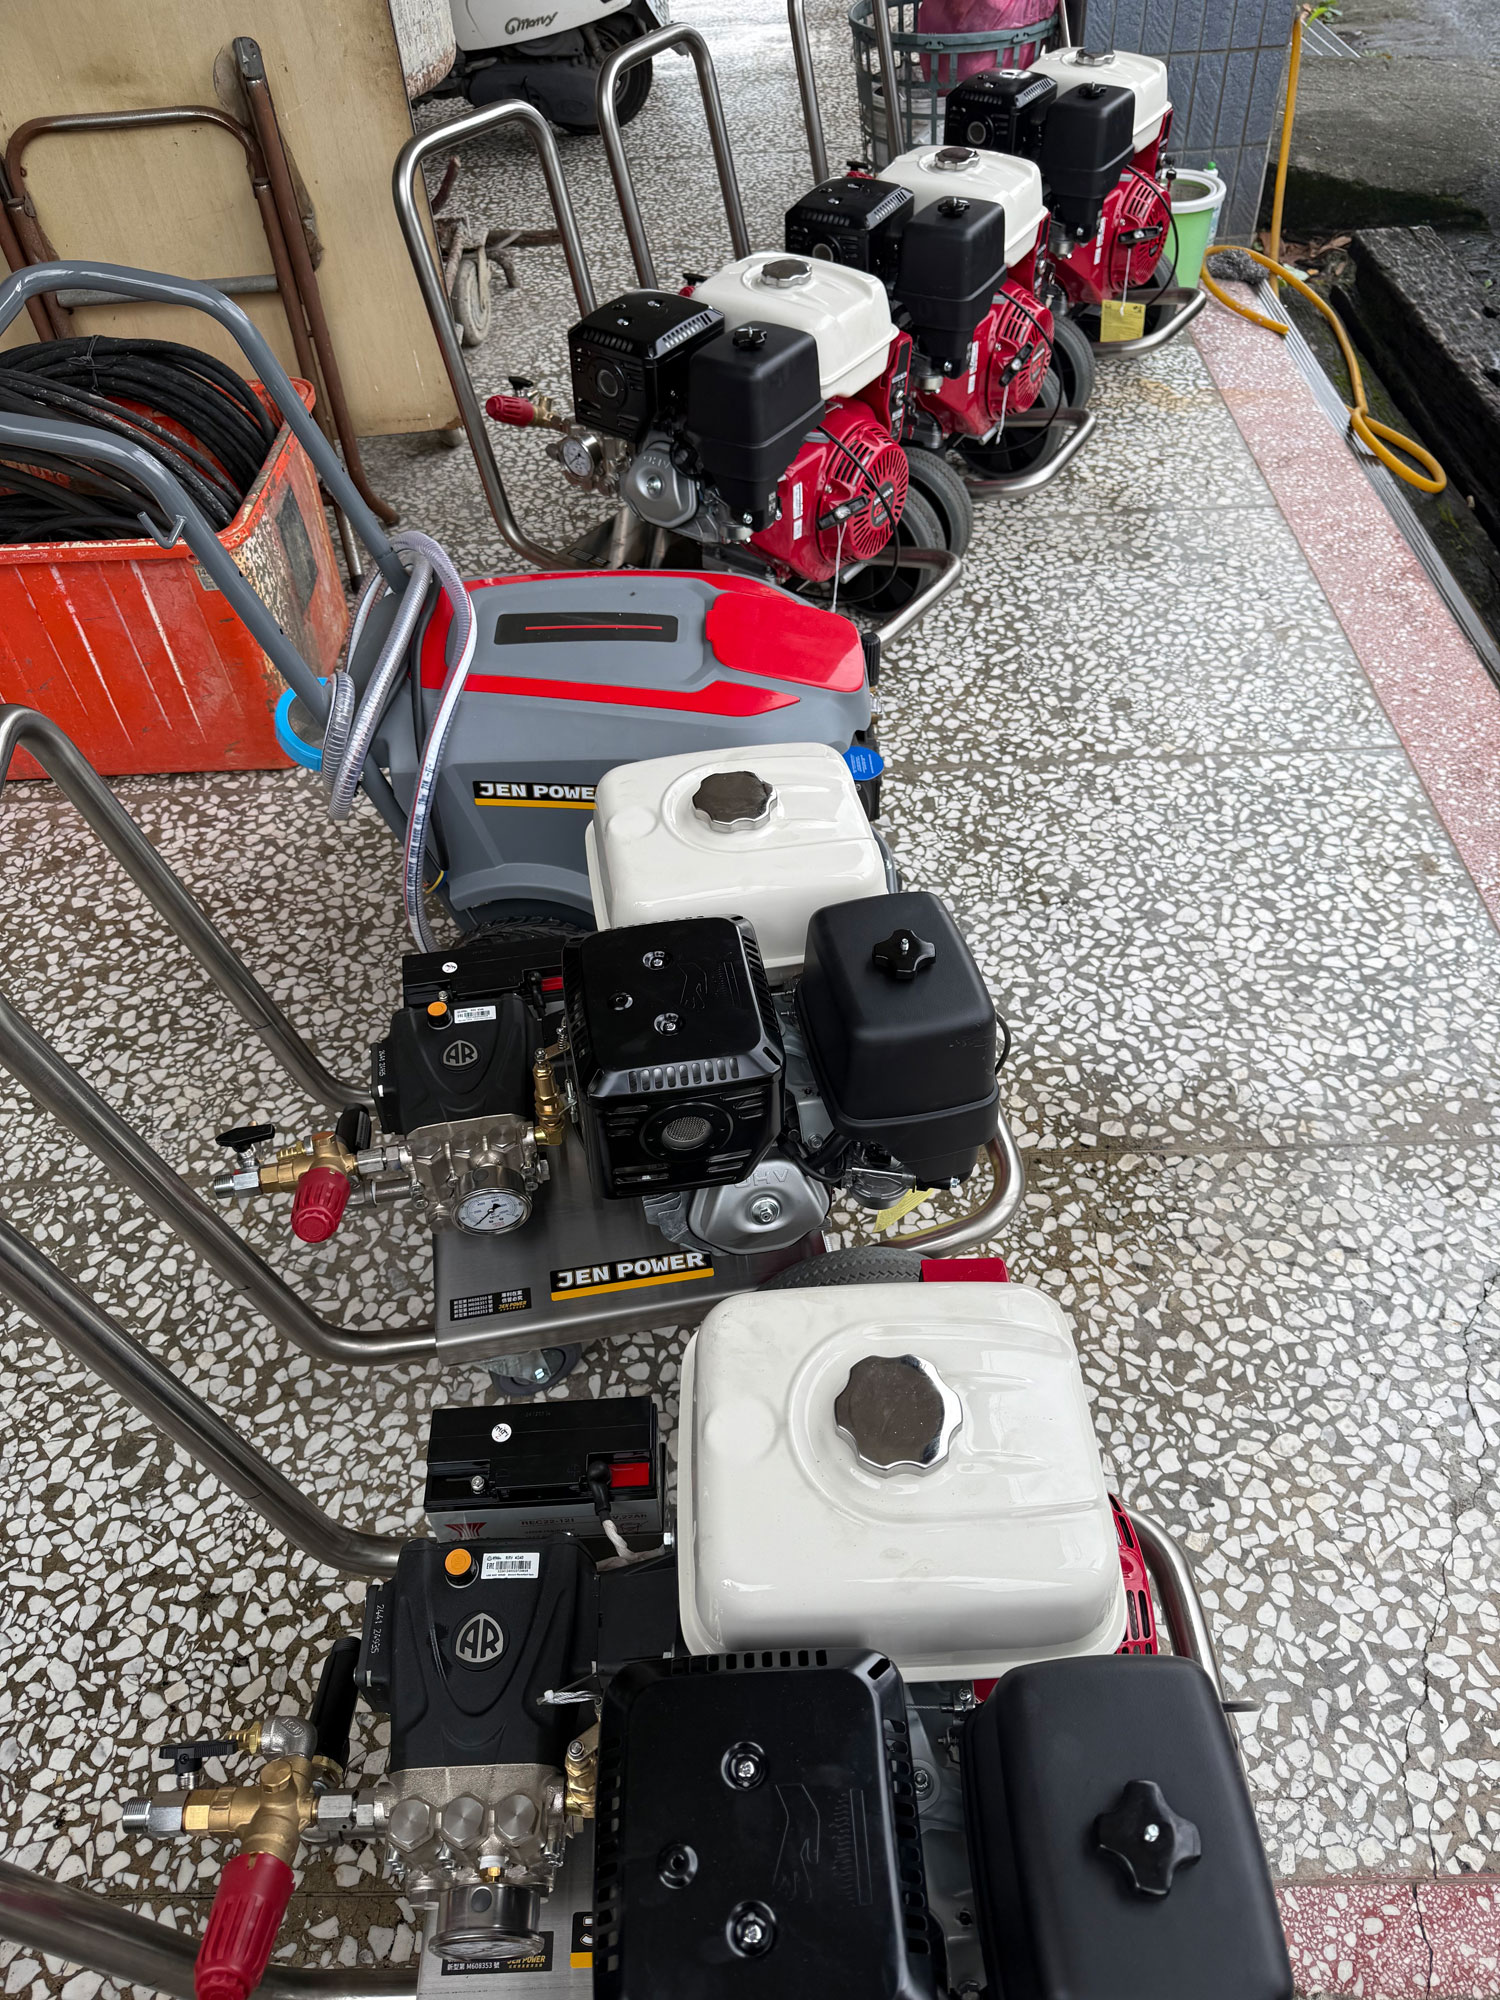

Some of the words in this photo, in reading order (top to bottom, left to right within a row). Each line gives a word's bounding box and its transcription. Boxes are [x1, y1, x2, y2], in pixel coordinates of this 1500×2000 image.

[480, 783, 527, 797] JEN
[533, 785, 597, 800] POWE
[443, 1040, 478, 1066] AR
[556, 1265, 610, 1288] JEN
[616, 1252, 706, 1279] POWER
[456, 1613, 504, 1662] AR
[466, 1962, 492, 1970] M608353
